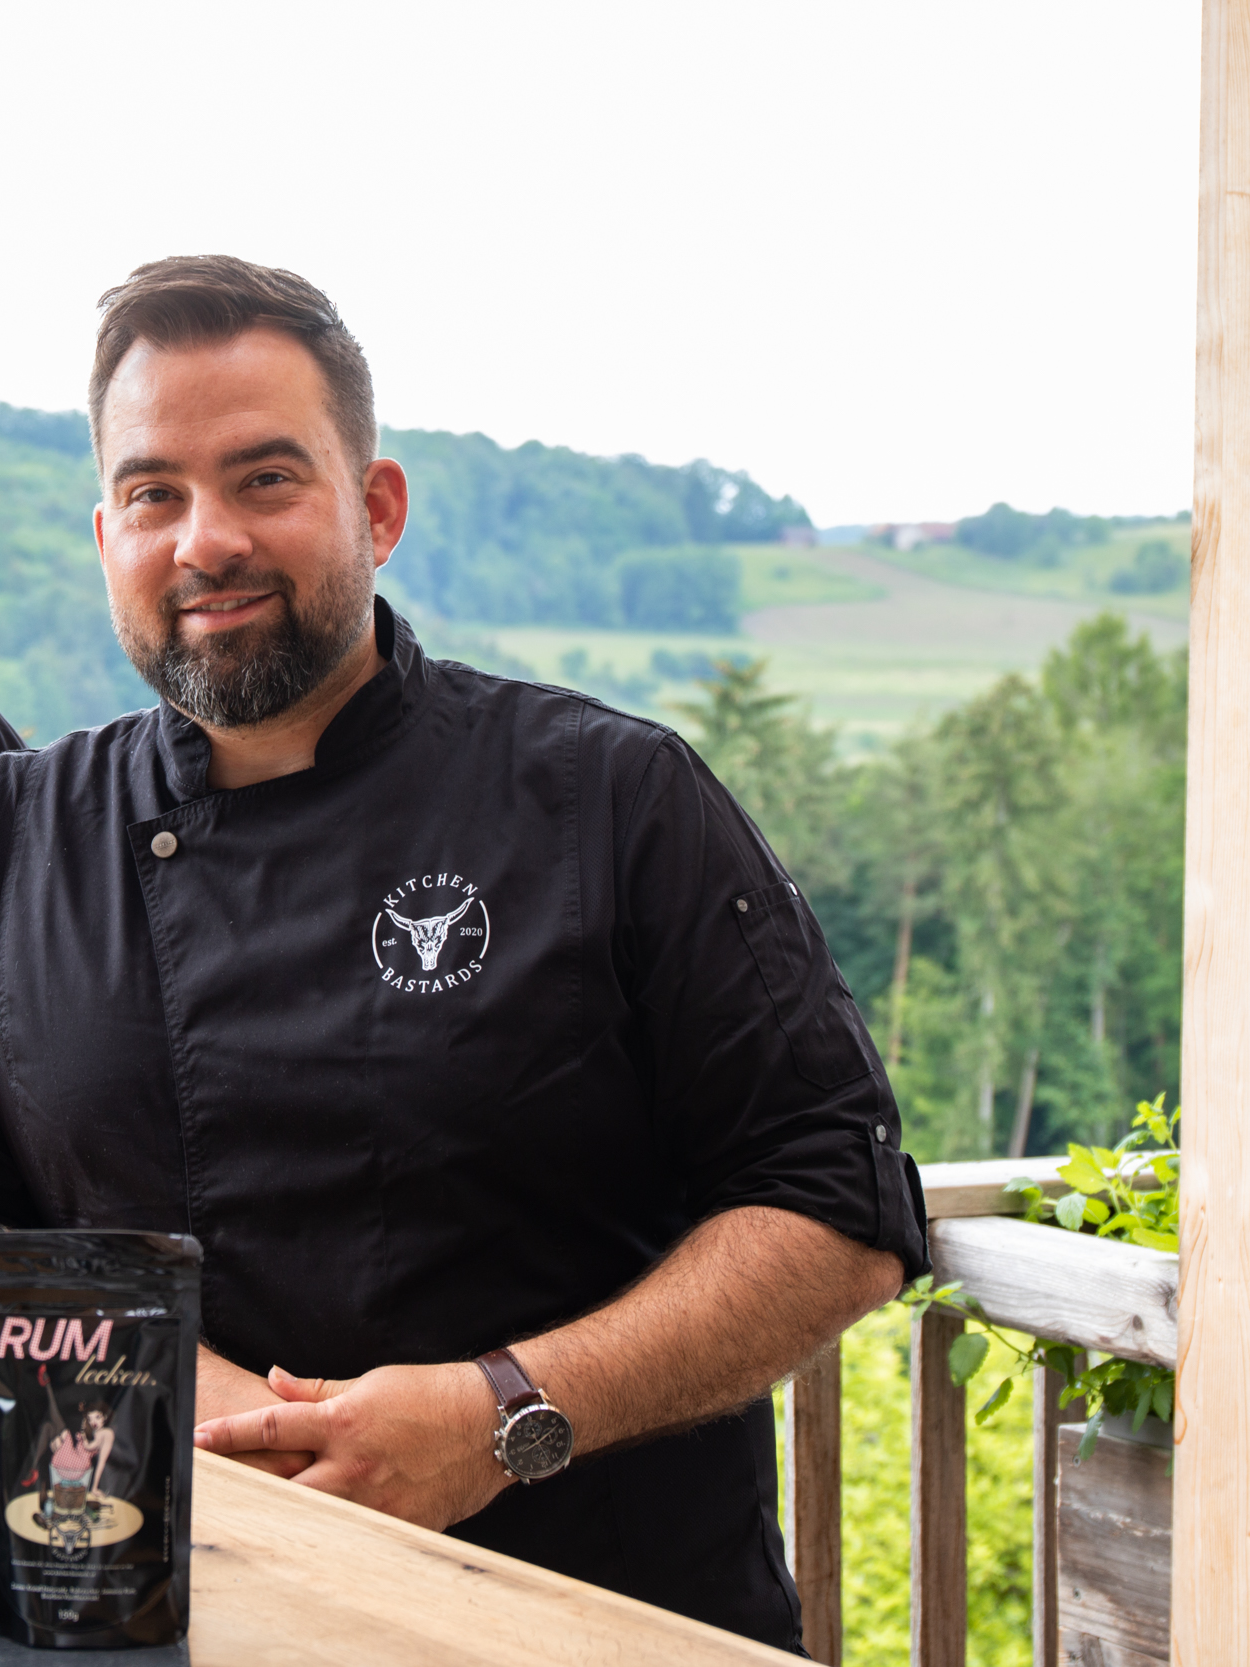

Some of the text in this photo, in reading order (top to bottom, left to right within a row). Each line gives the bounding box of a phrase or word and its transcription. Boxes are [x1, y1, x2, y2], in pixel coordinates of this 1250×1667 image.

[383, 872, 478, 908] KITCHEN
[382, 927, 483, 947] est. 2020
[381, 960, 482, 993] BASTARDS
[75, 1354, 157, 1387] lecken.
